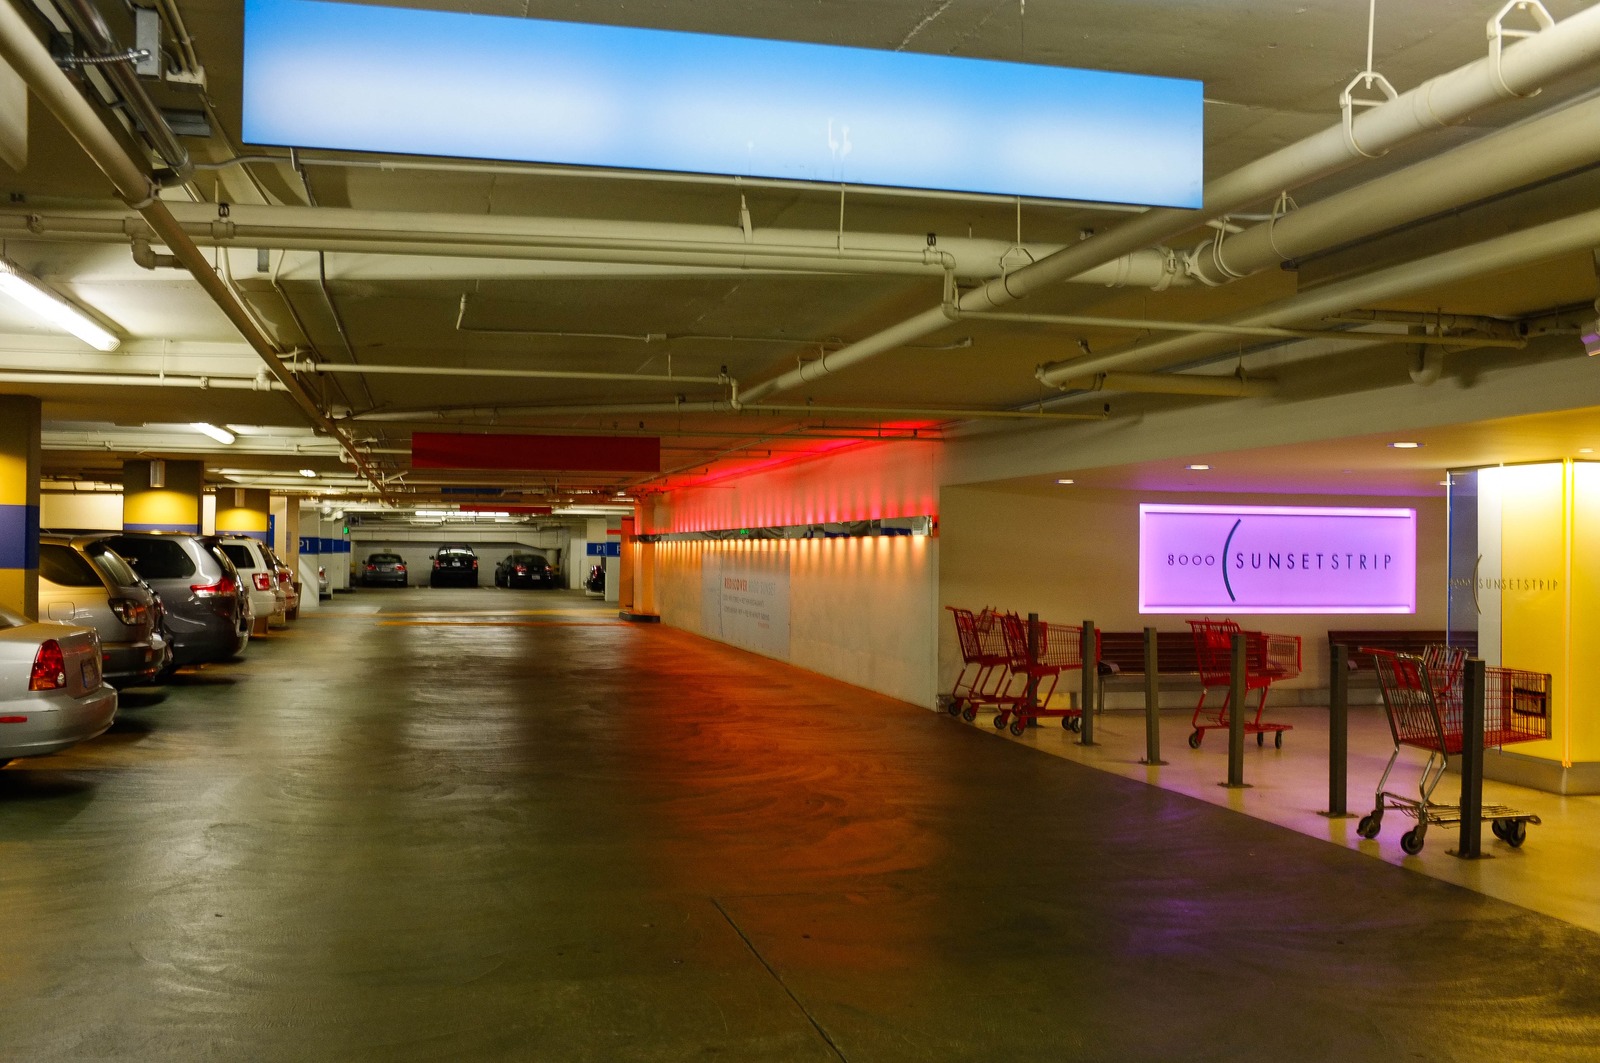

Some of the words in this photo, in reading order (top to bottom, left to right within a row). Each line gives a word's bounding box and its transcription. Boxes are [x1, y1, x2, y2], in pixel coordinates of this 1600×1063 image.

[1167, 554, 1215, 566] 8000
[1236, 553, 1392, 570] SUNSETSTRIP
[1479, 577, 1558, 591] SUNSETSTRIP
